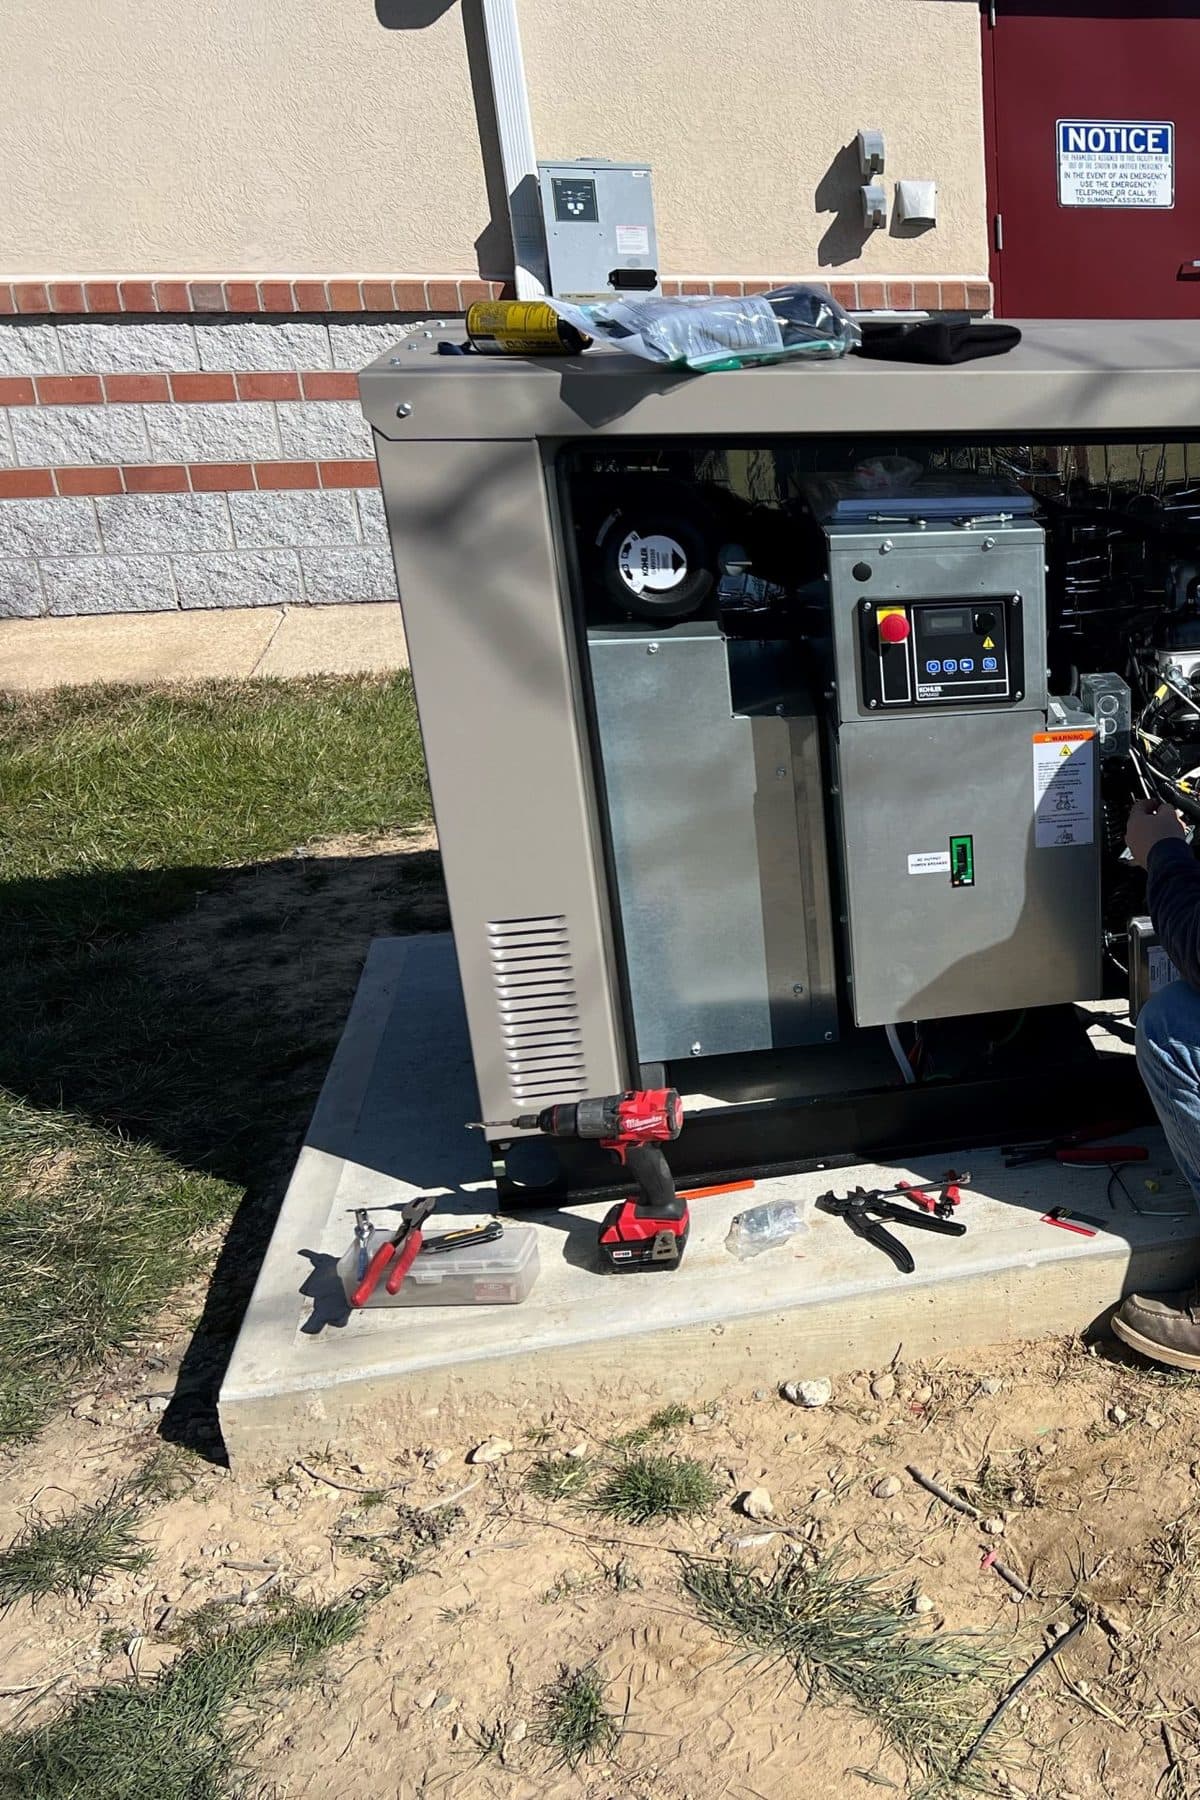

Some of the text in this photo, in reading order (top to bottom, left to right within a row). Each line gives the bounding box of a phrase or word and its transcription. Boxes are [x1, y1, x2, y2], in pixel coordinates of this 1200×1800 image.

[1068, 127, 1163, 153] NOTICE
[640, 547, 649, 577] KOHLER
[1052, 733, 1084, 742] WARNING
